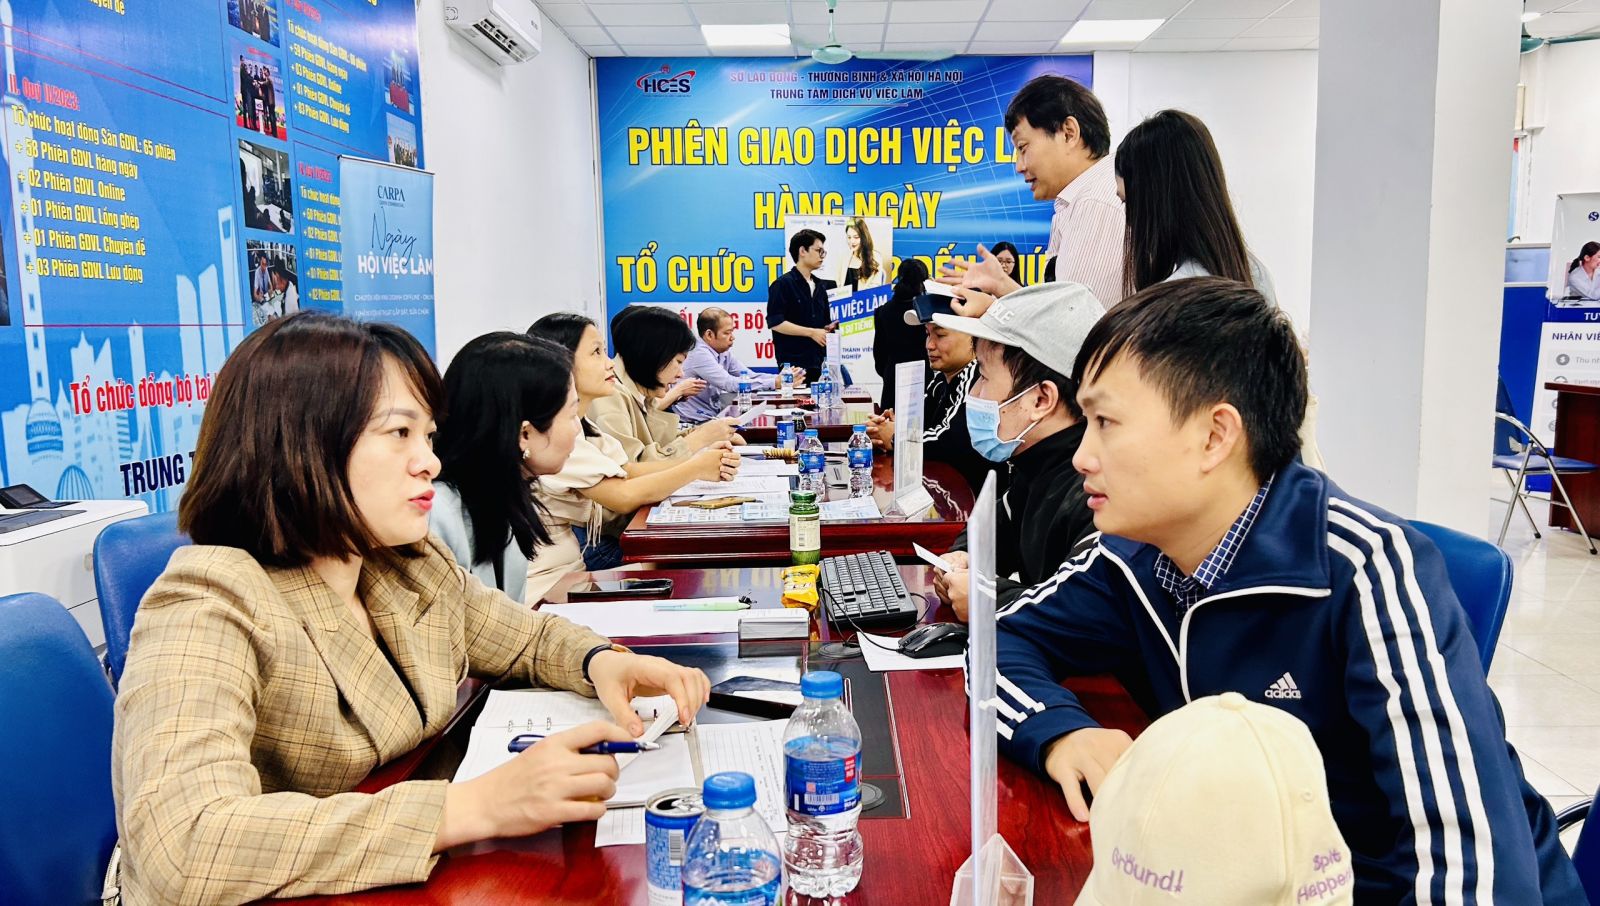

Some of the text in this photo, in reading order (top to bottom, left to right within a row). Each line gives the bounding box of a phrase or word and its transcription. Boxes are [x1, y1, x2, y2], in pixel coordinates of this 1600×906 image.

[10, 74, 20, 96] II.
[22, 77, 41, 103] Quý
[644, 78, 690, 93] HCES
[747, 72, 766, 82] LAO
[769, 70, 797, 84] ĐỘNG
[808, 71, 848, 82] THƯƠNG
[880, 72, 888, 82] &
[891, 69, 904, 82] XÃ
[908, 69, 925, 84] HỘI
[944, 69, 963, 84] NỘI
[770, 86, 923, 101] TRUNG TÂM DỊCH VỤ VIỆC LÀM
[12, 104, 176, 162] Tổ chức hoạt động Sàn GDVL: 65 phiên
[628, 119, 728, 166] PHIÊN
[738, 127, 815, 166] GIAO
[825, 127, 901, 173] DỊCH
[912, 118, 984, 172] VIỆC
[25, 137, 38, 158] 58
[41, 142, 68, 164] Phiên
[71, 148, 94, 169] GDVL
[96, 153, 116, 176] hàng
[119, 160, 138, 180] ngày
[28, 169, 41, 189] 02
[44, 171, 71, 193] Phiên
[74, 177, 96, 196] GDVL
[99, 181, 126, 201] Online
[378, 184, 405, 202] CARPA
[30, 198, 42, 216] 01
[46, 199, 72, 221] Phiên
[75, 204, 97, 224] GDVL
[854, 184, 942, 229] NGÀY
[34, 228, 45, 247] 01
[49, 229, 76, 250] Phiên
[79, 233, 101, 252] GDVL
[104, 236, 134, 256] Chuyên
[372, 206, 417, 267] Ngày
[36, 258, 49, 276] 03
[52, 258, 79, 277] Phiên
[82, 261, 104, 279] GDVL
[106, 262, 120, 280] Lưu
[123, 264, 143, 284] động
[358, 252, 434, 279] HỘI VIỆC LÀM
[616, 241, 658, 293] TỔ
[667, 248, 754, 293] CHỨC
[841, 298, 864, 318] VIỆC
[866, 294, 888, 312] LÀM
[745, 310, 764, 333] BỘ
[1552, 331, 1582, 340] NHÂN
[754, 339, 774, 359] VỚ
[70, 372, 211, 415] Tổ chức đồng bộ tại
[120, 454, 185, 497] TRUNG
[1264, 688, 1301, 699] adidas
[1312, 848, 1341, 873] Spit
